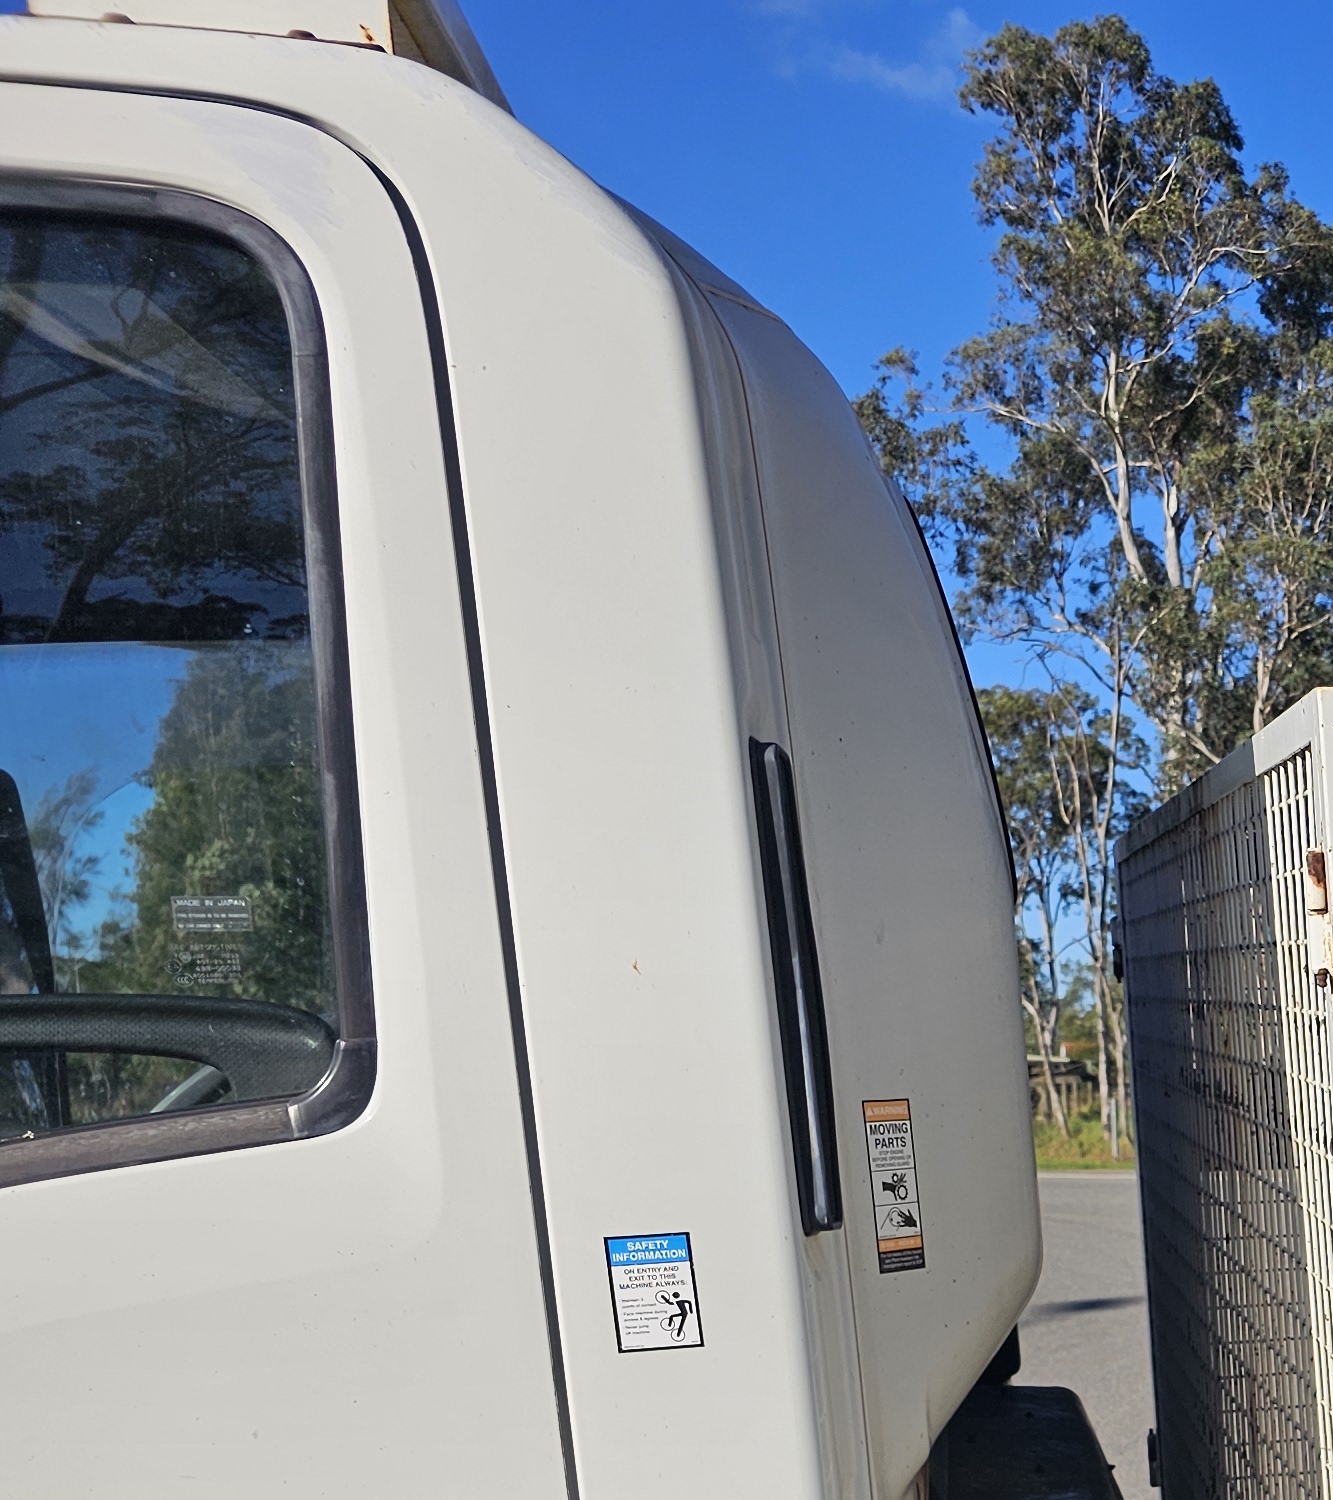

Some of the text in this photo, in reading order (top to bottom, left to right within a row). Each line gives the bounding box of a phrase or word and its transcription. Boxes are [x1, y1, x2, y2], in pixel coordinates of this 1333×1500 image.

[218, 899, 246, 907] JAPAN
[869, 1122, 908, 1136] MOVING
[875, 1136, 906, 1149] PARTS
[627, 1240, 669, 1251] SAFETY
[612, 1249, 686, 1262] INFORMATION
[619, 1282, 654, 1290] MACHINE
